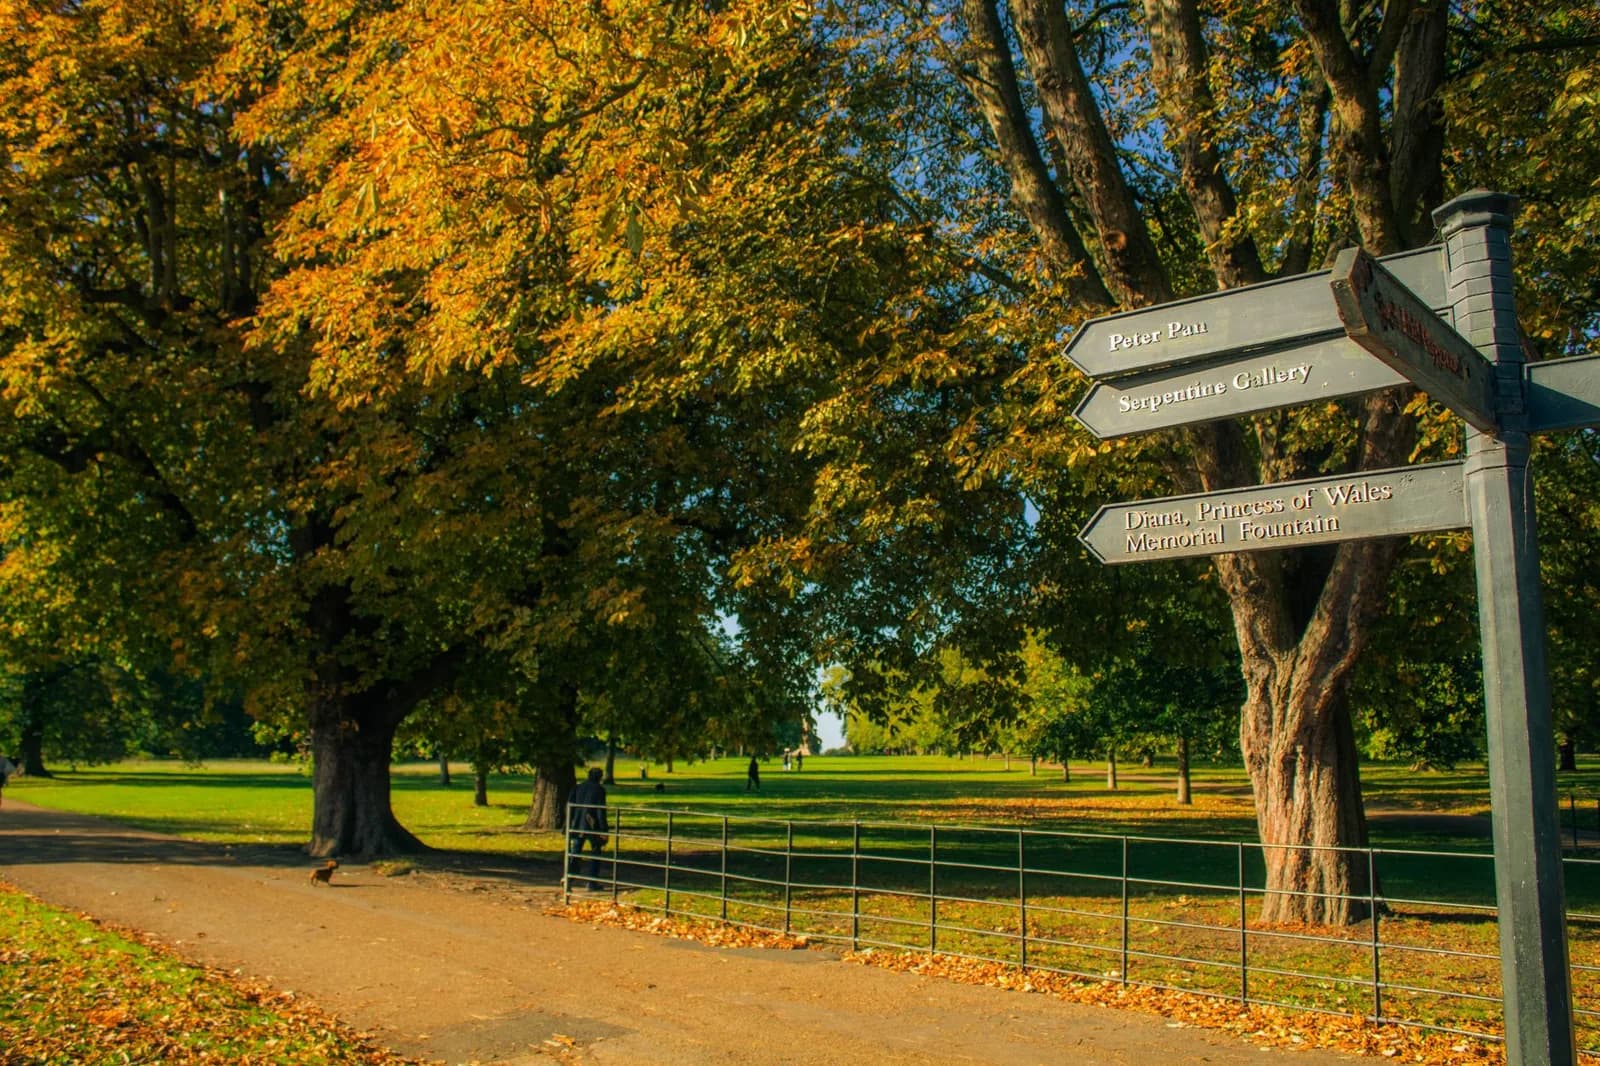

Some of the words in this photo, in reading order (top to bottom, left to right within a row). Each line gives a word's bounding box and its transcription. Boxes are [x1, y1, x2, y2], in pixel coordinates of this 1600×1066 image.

[1109, 330, 1161, 351] Peter
[1168, 319, 1208, 340] Pan
[1119, 379, 1227, 413] Serpentine
[1232, 363, 1312, 391] Gallery
[1124, 508, 1190, 531] Diana,
[1197, 496, 1284, 522] Princess
[1291, 488, 1317, 511] of
[1322, 481, 1394, 505] Wales
[1124, 524, 1224, 553] Memorial
[1239, 514, 1340, 542] Fountain
